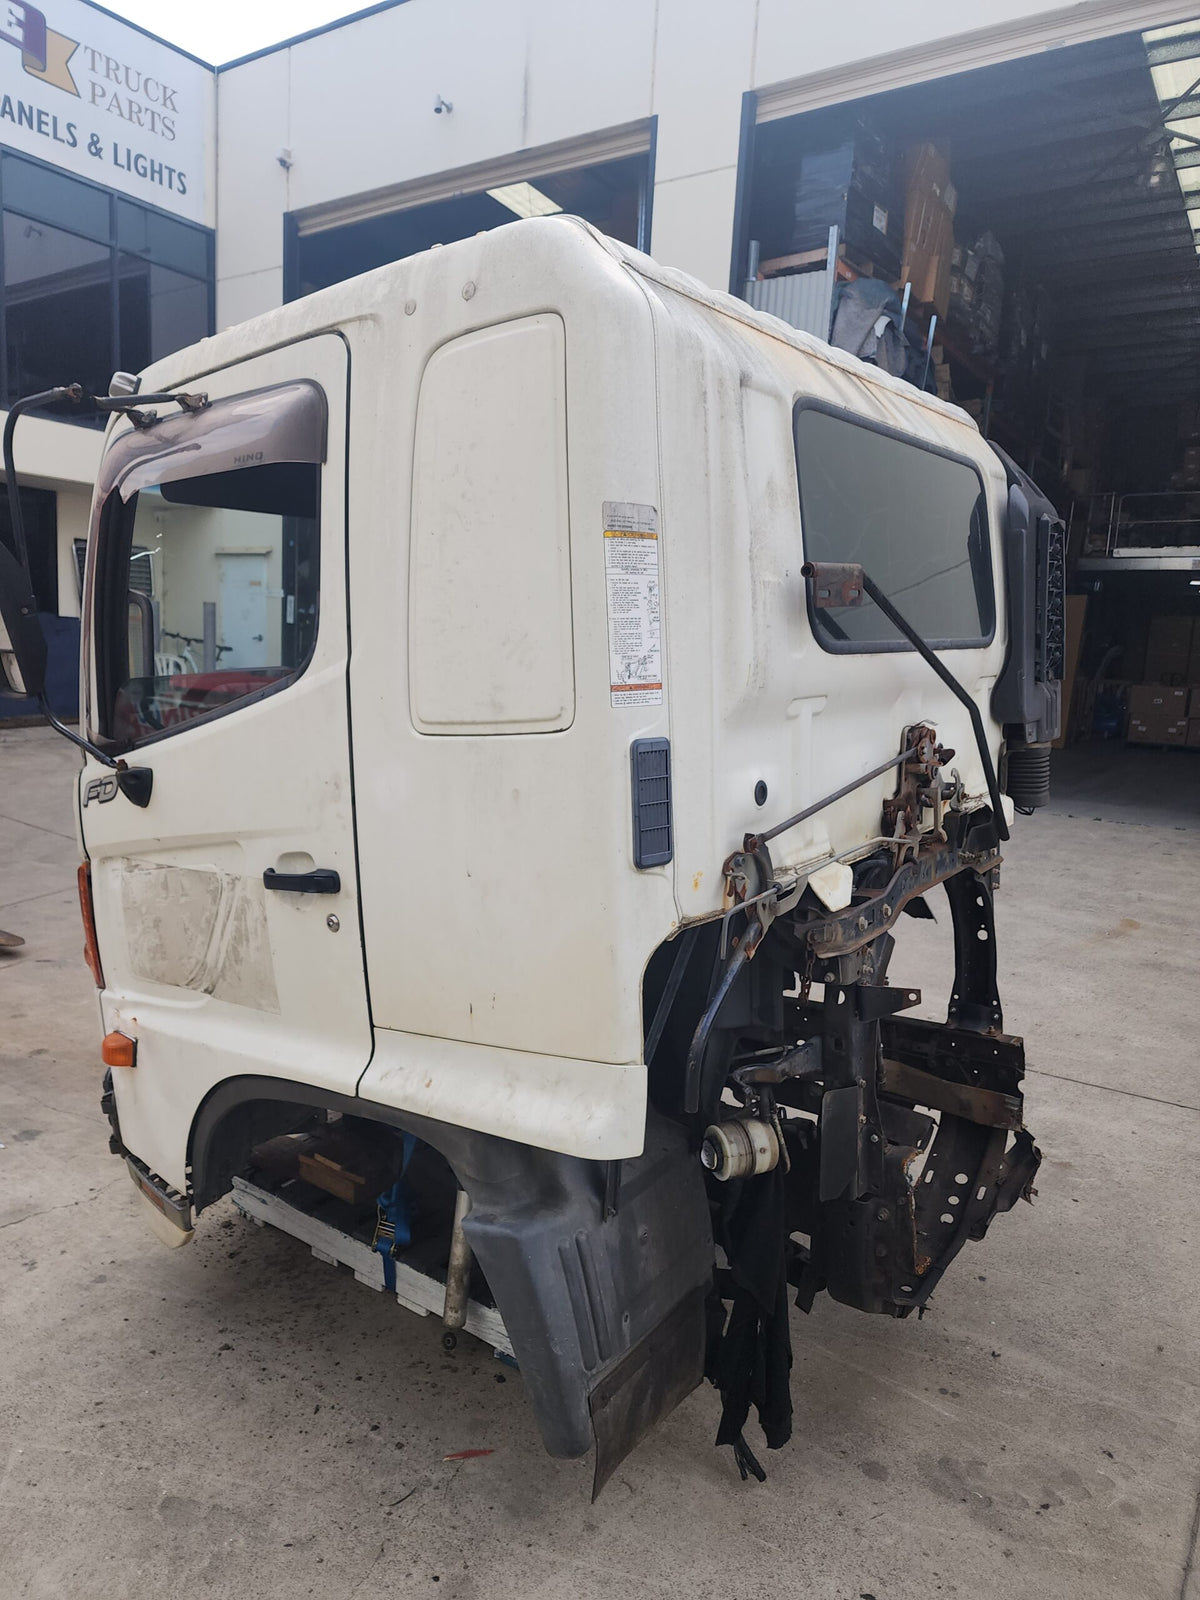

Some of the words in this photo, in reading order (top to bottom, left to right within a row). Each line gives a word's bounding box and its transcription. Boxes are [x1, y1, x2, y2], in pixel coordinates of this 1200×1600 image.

[84, 45, 179, 114] TRUCK
[88, 80, 176, 141] PARTS
[0, 94, 78, 148] ANELS
[87, 132, 103, 160] &
[113, 142, 187, 195] LIGHTS
[233, 451, 264, 464] HINO
[83, 774, 119, 808] FD
